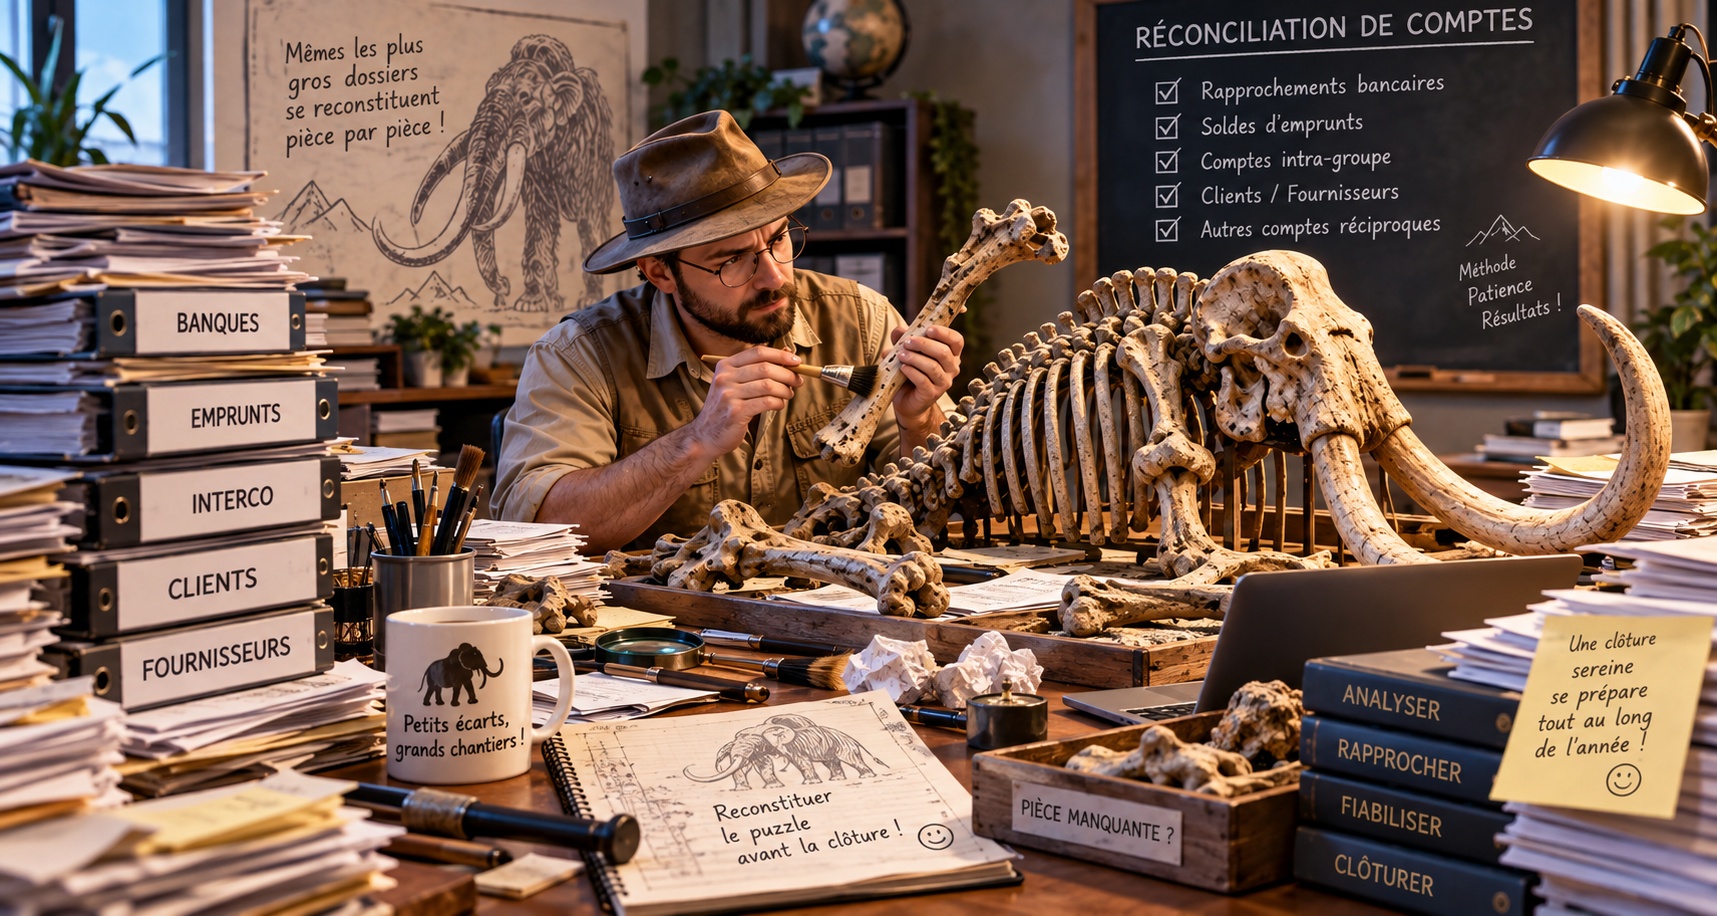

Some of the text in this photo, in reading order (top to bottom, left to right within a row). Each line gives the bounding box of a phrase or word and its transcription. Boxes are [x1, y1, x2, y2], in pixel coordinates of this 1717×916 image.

[1137, 8, 1532, 48] RÉCONCILIATION DE COMPTES
[286, 33, 423, 64] Mêmes les plus
[288, 64, 417, 100] gros dossiers
[1202, 74, 1444, 105] Rapprochements bancaires
[286, 85, 440, 120] se reconstituent
[287, 110, 445, 158] pièce par pièce !
[1202, 115, 1255, 135] Soldes
[1201, 151, 1391, 175] Comptes intra-groupe
[1202, 184, 1398, 204] Clients / Fournisseurs
[1201, 216, 1440, 242] Autres comptes réciproques
[1460, 254, 1516, 281] Méthode
[1468, 280, 1533, 306] Patience
[178, 313, 259, 335] BANQUES
[1482, 292, 1562, 329] Résultats !
[192, 403, 280, 428] EMPRUNTS
[193, 486, 273, 514] INTERCO
[169, 568, 257, 599] CLIENTS
[1570, 631, 1656, 652] Une clôture
[142, 636, 291, 681] FOURNISSEURS
[1572, 660, 1633, 678] sereine
[1342, 684, 1440, 722] ANALYSER
[1551, 684, 1648, 710] se prépare
[404, 711, 508, 733] Petits écarts,
[1539, 707, 1652, 731] tout au long
[395, 727, 525, 762] grands chantiers !
[1535, 738, 1556, 758] de
[1640, 730, 1648, 751] !
[1338, 739, 1461, 783] RAPPROCHER
[713, 789, 832, 822] Reconstituer
[1022, 797, 1174, 844] PIÈCE MANQUANTE ?
[1342, 796, 1441, 837] FIABILISER
[721, 815, 812, 845] le puzzle
[738, 819, 902, 864] avant la clôture !
[1335, 854, 1433, 896] CLÔTURER
